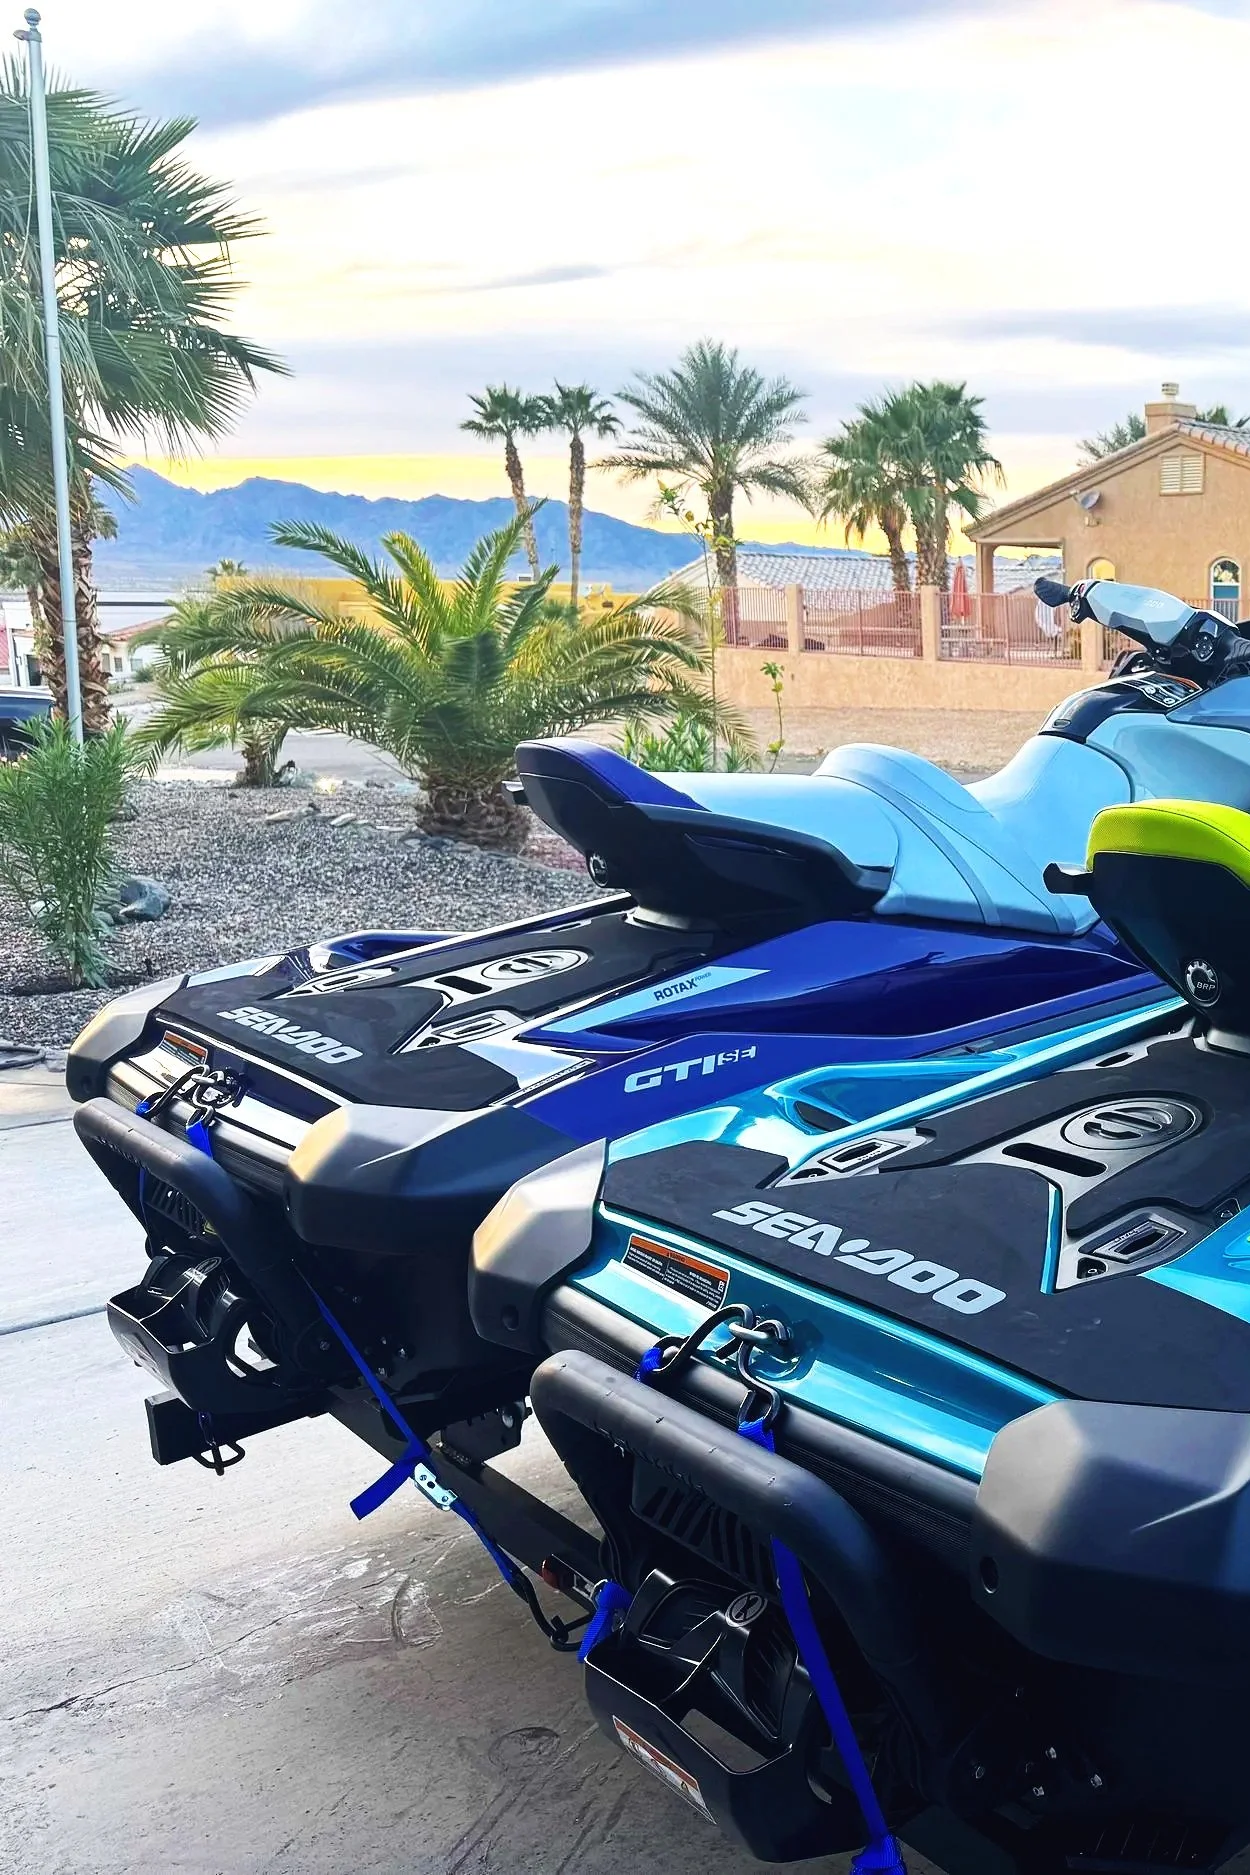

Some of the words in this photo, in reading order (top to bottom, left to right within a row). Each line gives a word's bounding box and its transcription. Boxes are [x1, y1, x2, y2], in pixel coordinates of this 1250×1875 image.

[653, 978, 698, 1002] ROTAX
[1196, 982, 1216, 991] BRP
[624, 1055, 716, 1093] GTI
[717, 1045, 757, 1066] SE
